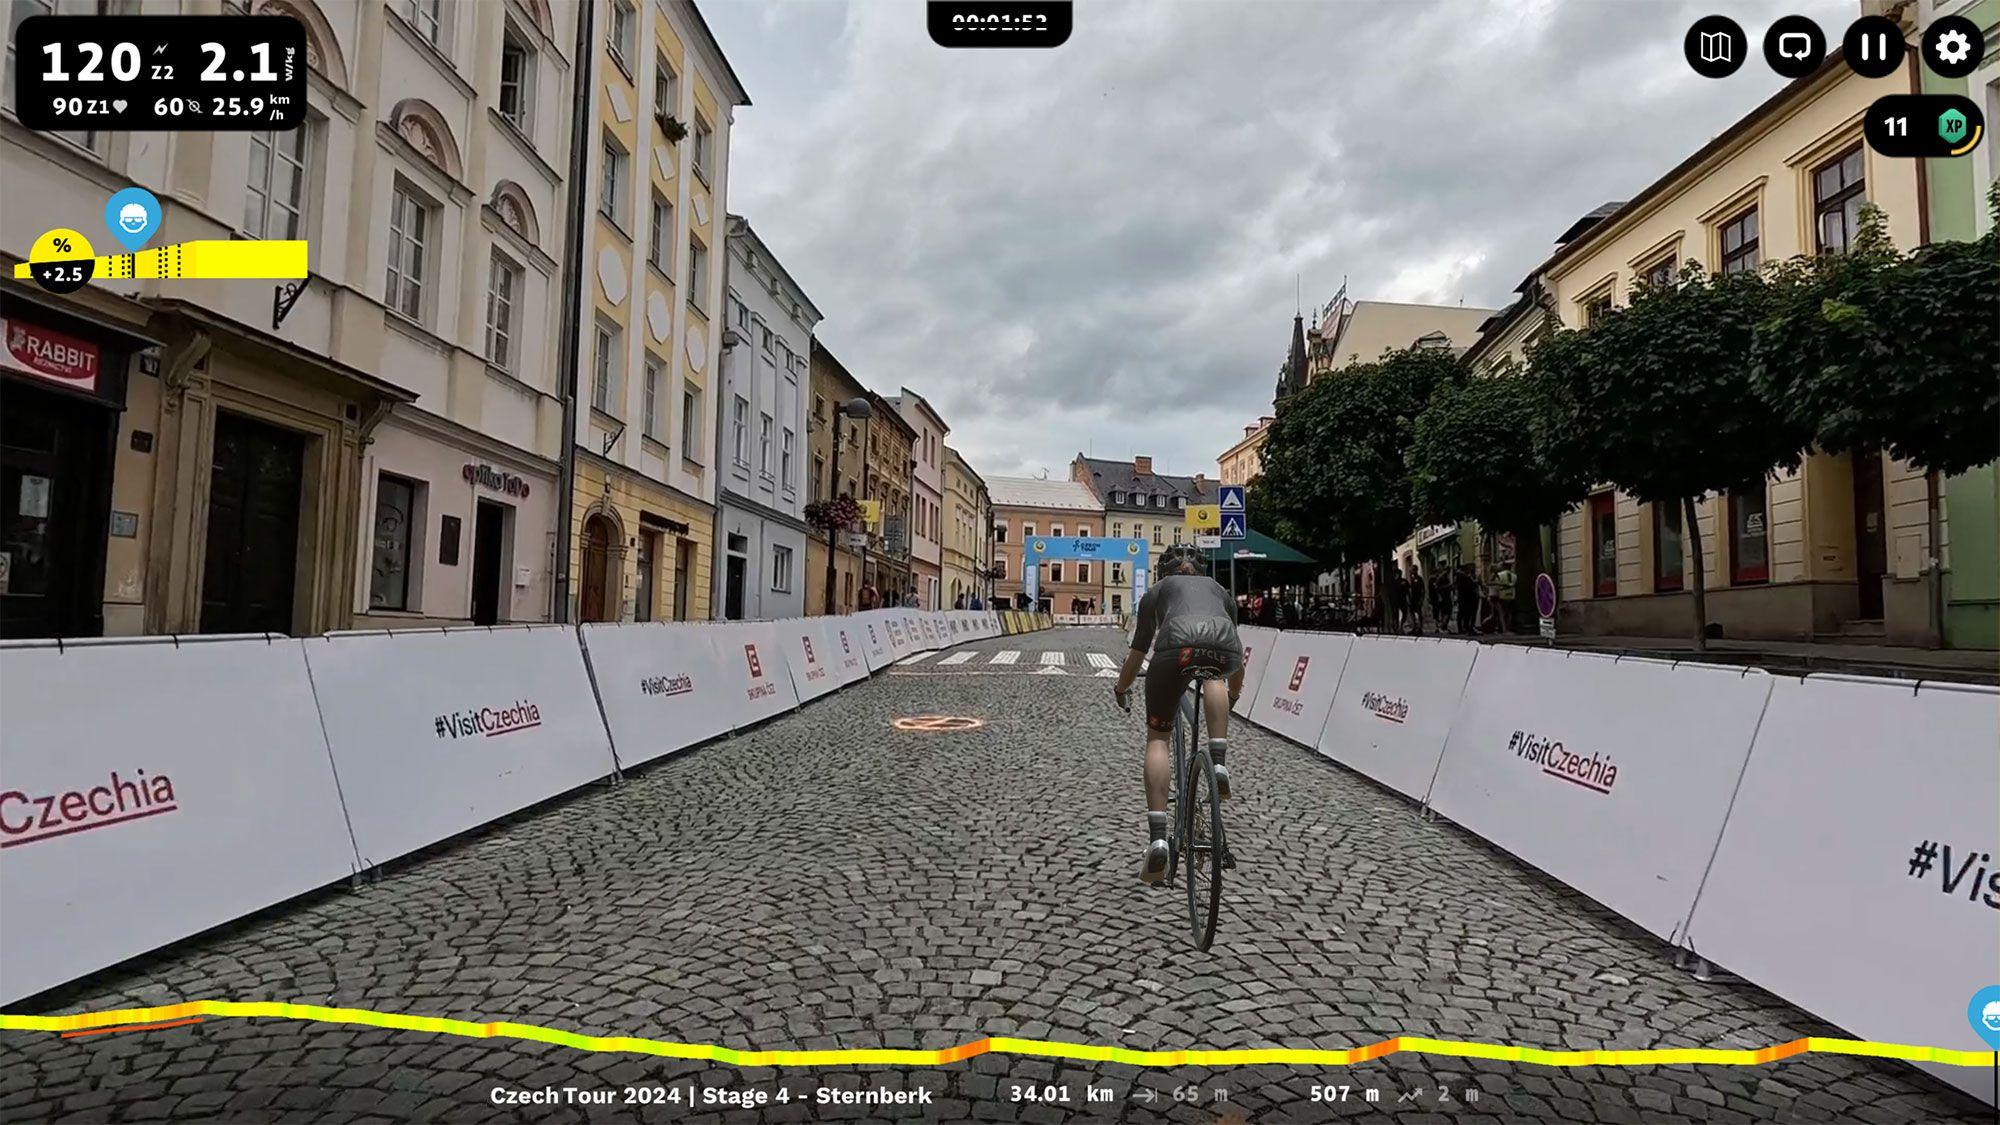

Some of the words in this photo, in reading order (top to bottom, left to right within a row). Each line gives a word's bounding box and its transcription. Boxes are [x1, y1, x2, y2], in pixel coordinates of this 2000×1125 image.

[27, 335, 95, 371] RABBIT
[1194, 648, 1226, 664] ZYCLE
[435, 699, 541, 738] #VisitCzechia
[1361, 691, 1409, 719] #VisitCzechia
[1508, 730, 1618, 788] #VisitCzechia
[0, 768, 175, 834] Czechia
